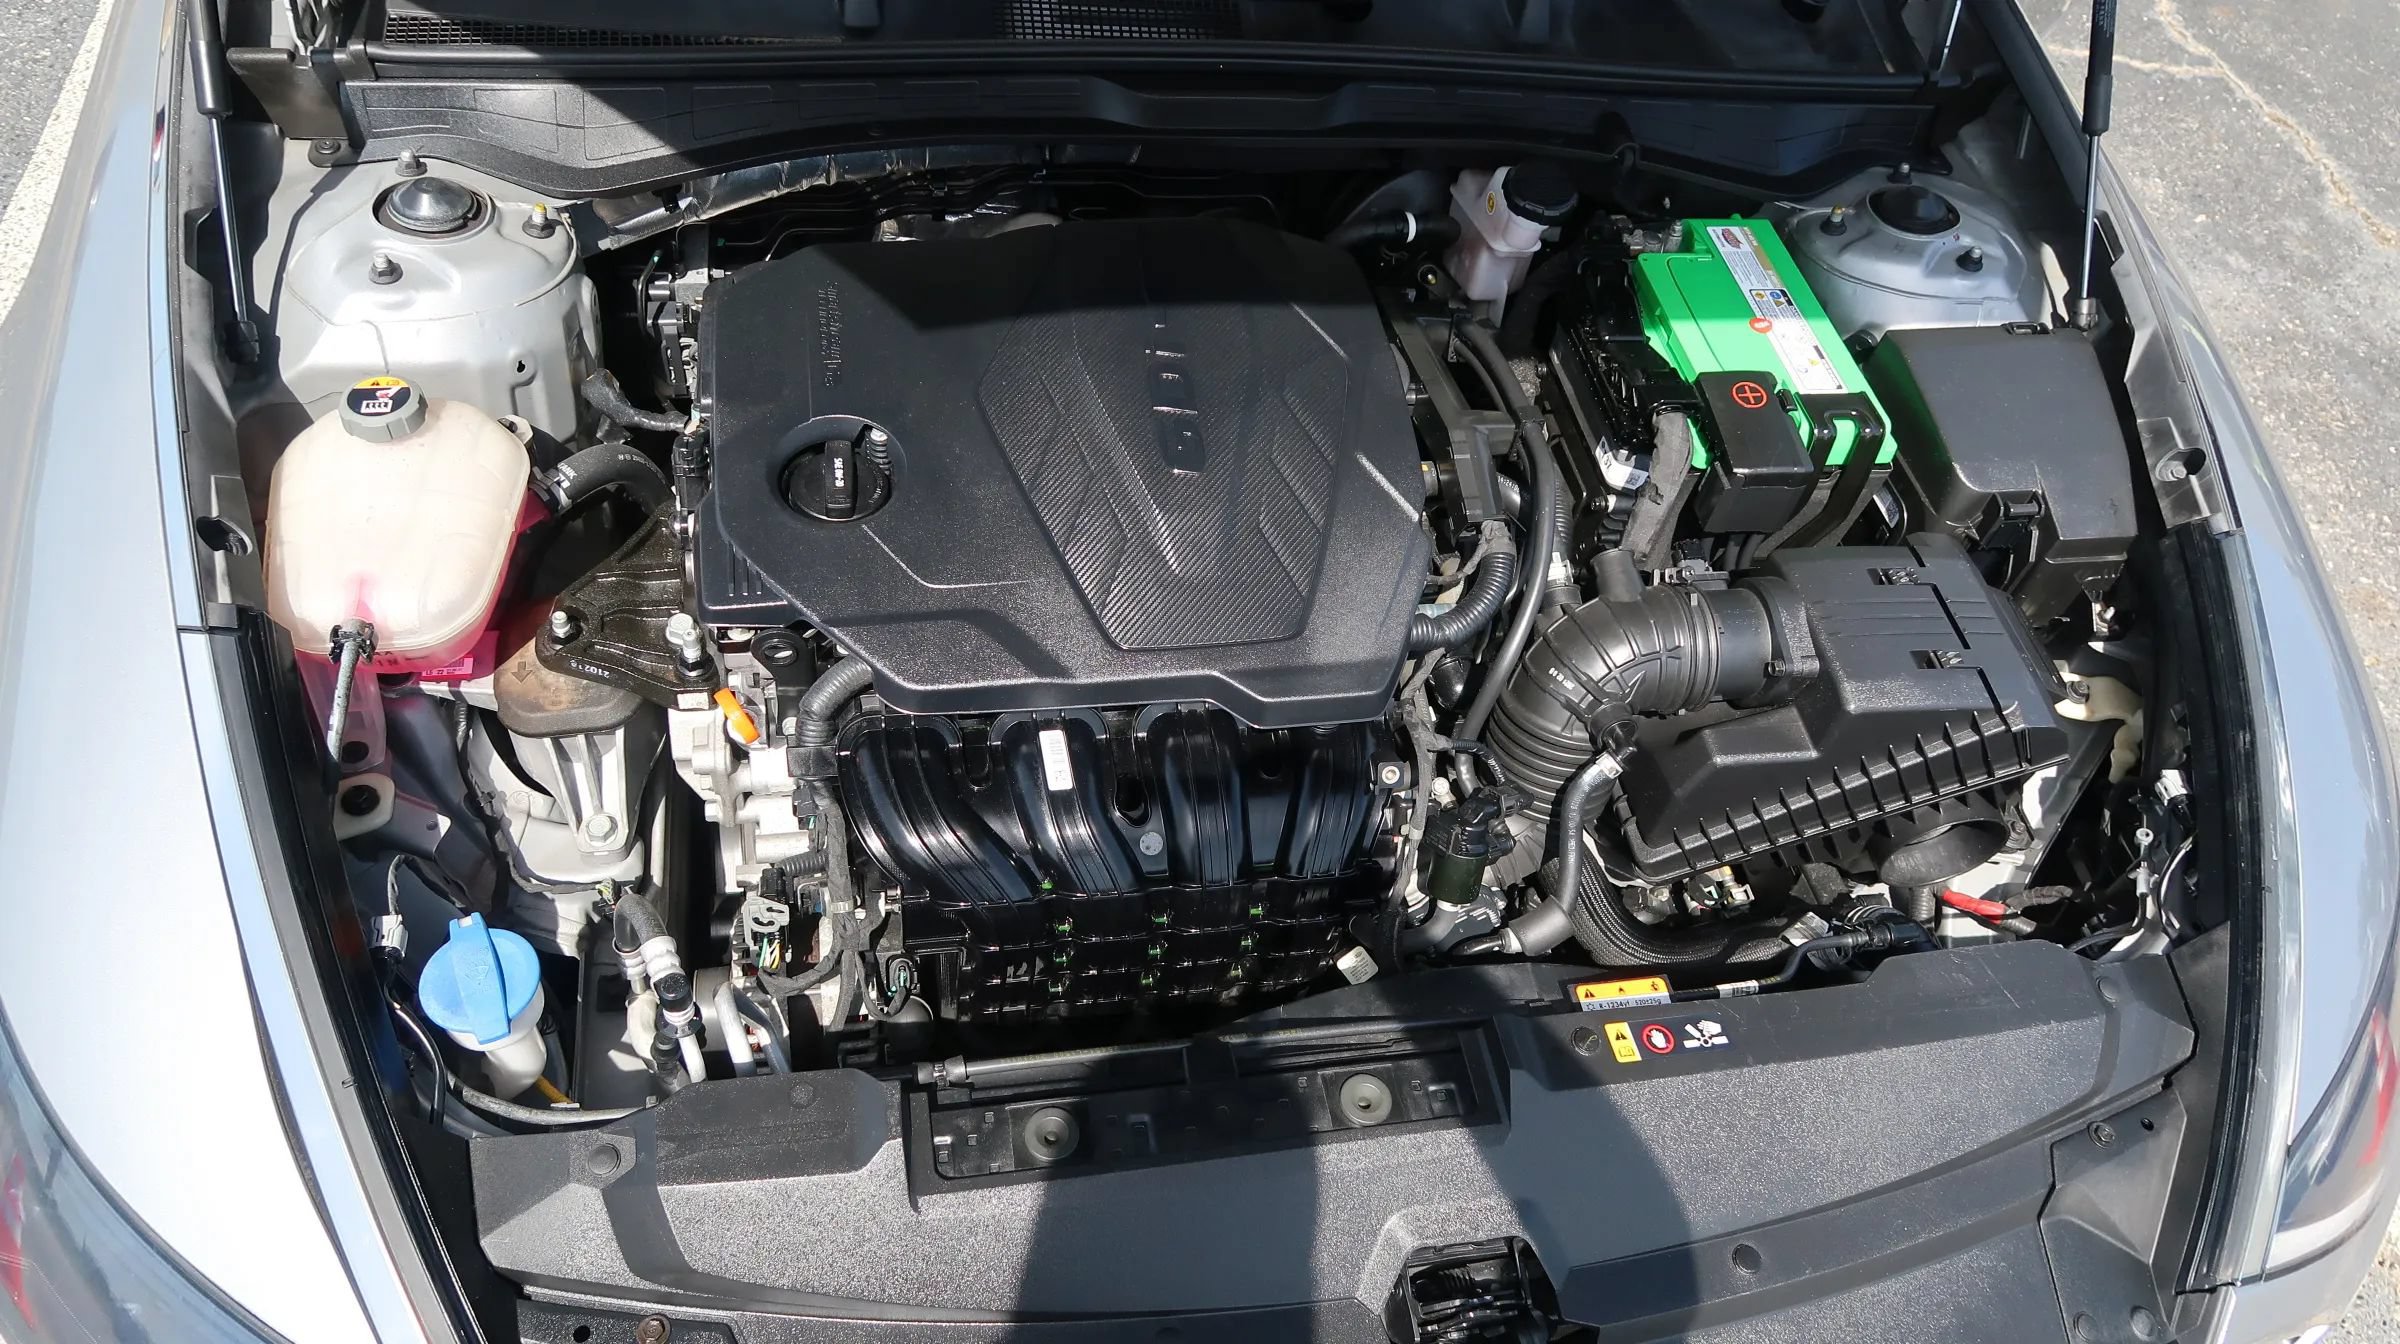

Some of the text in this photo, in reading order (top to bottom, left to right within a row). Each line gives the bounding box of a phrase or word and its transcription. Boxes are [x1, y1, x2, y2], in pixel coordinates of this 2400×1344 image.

[557, 462, 578, 480] TANK
[834, 457, 844, 487] SAE 0W-20
[1598, 1000, 1630, 1010] R-1234yf
